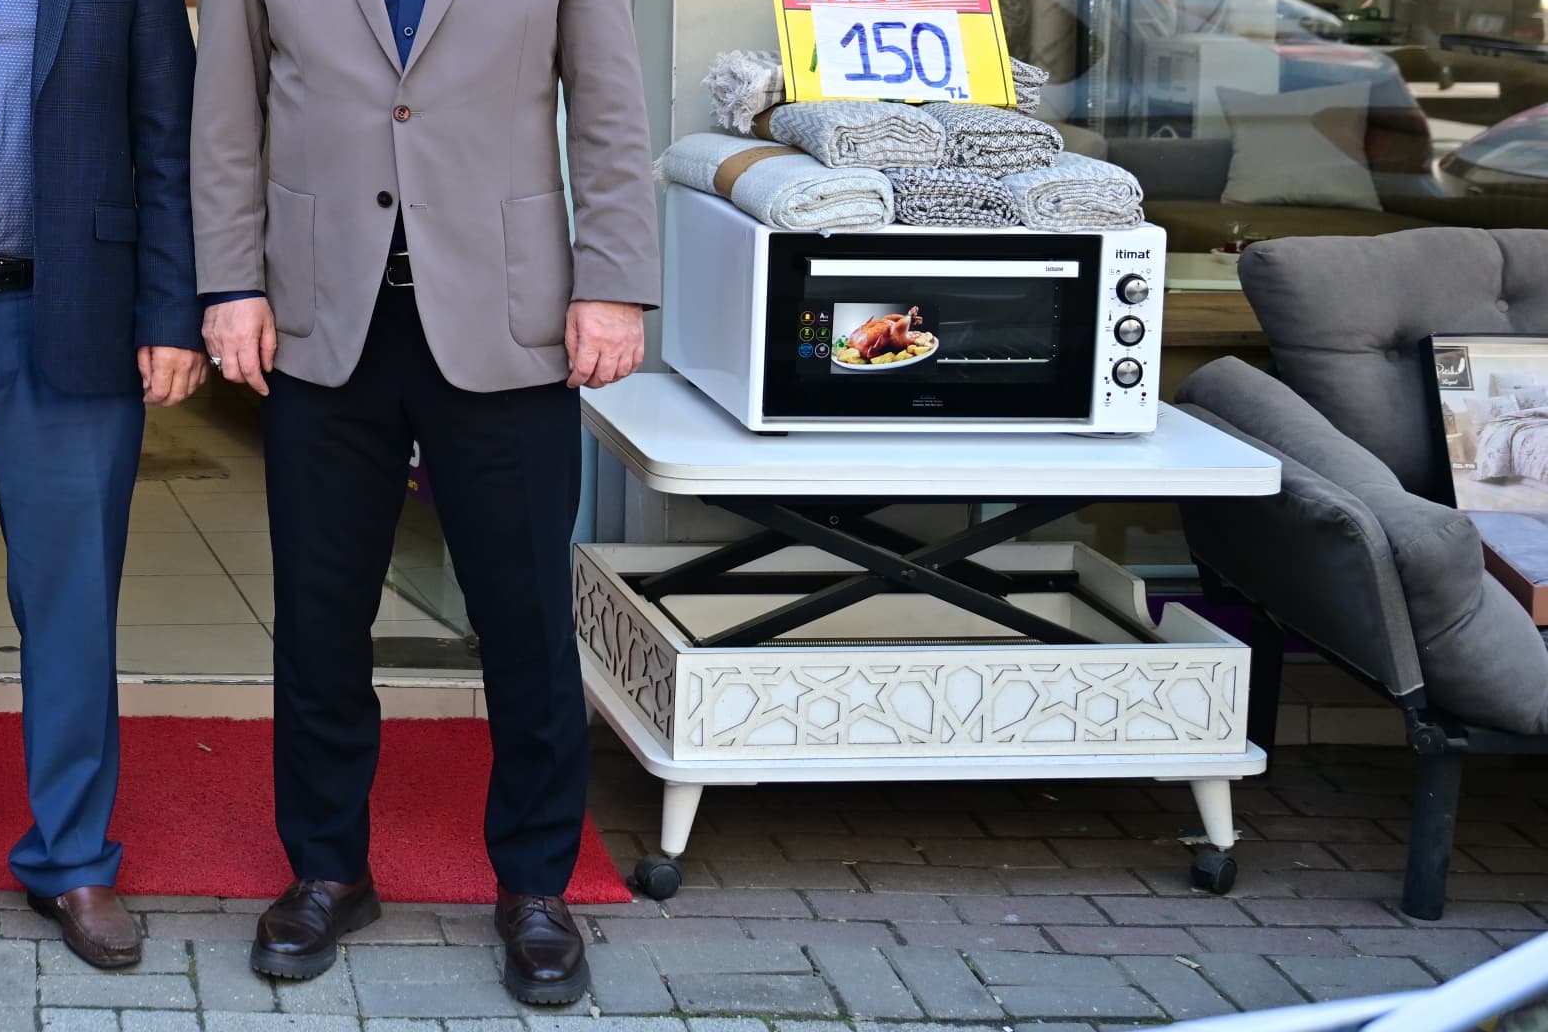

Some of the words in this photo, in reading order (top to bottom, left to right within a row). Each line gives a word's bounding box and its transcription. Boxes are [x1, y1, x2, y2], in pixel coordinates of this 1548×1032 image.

[840, 21, 952, 88] 150
[944, 86, 969, 99] TL
[1115, 248, 1151, 259] itimat
